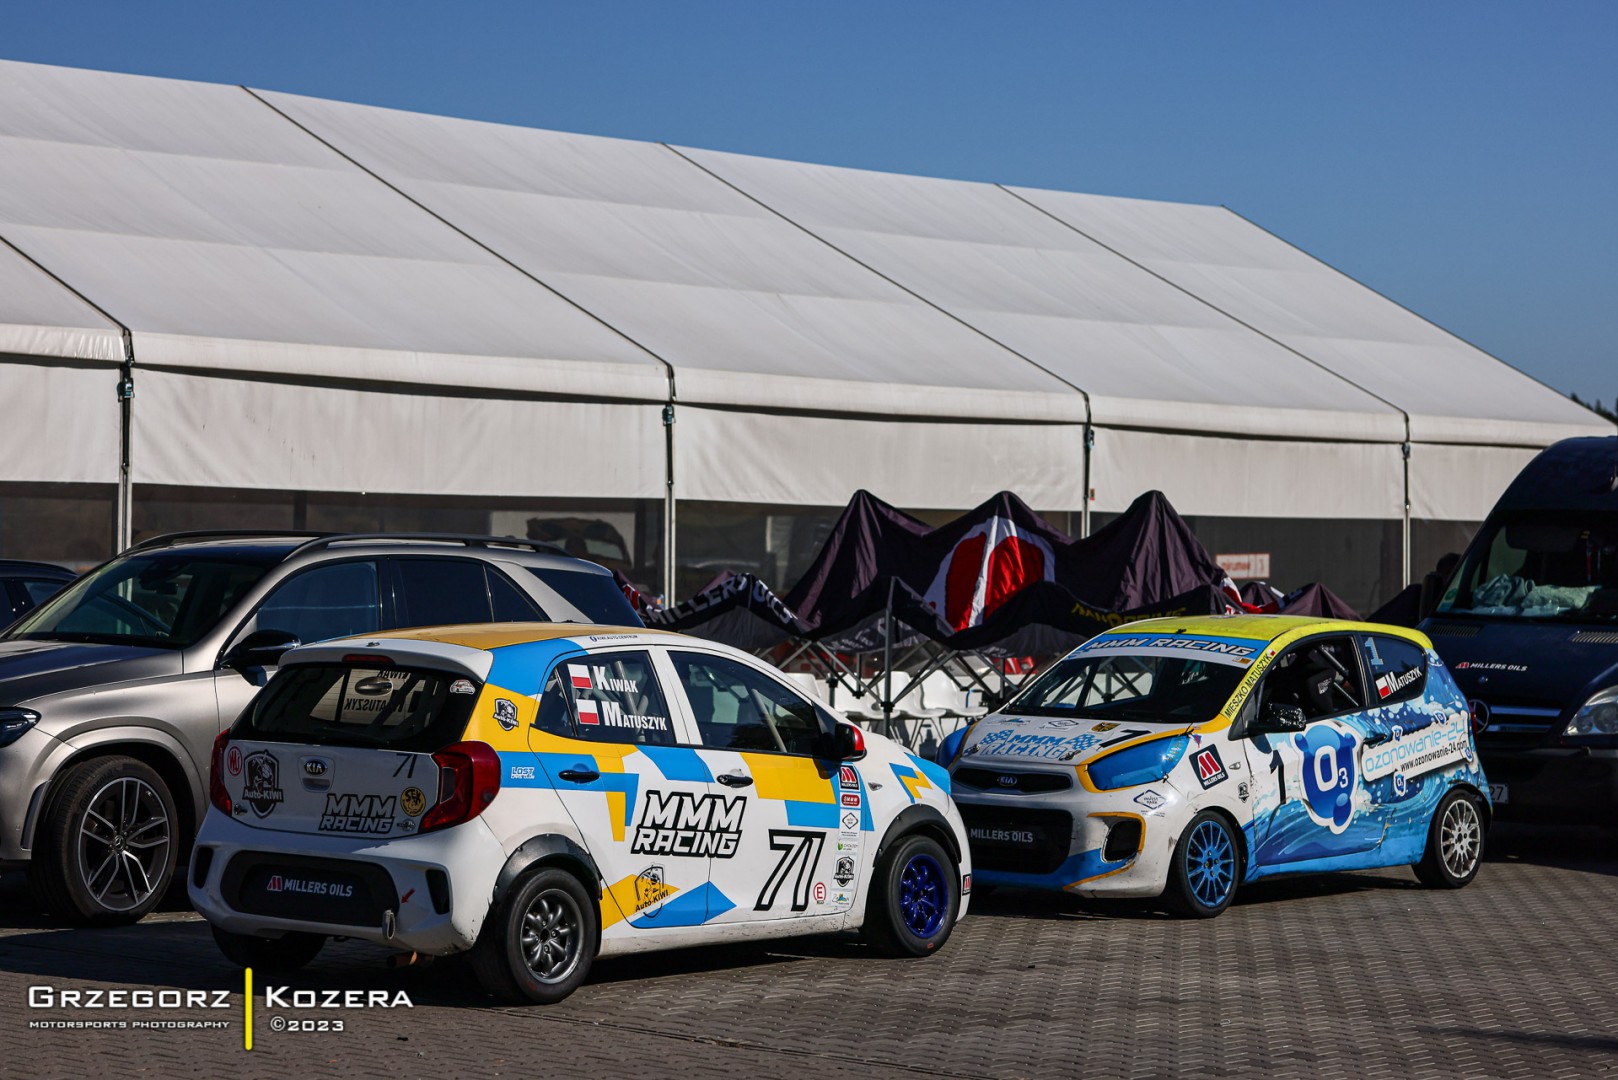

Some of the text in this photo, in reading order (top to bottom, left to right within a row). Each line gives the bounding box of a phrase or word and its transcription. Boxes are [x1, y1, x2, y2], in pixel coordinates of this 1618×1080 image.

[1085, 637, 1257, 657] MMM RACING
[1364, 637, 1384, 666] 1
[1470, 662, 1507, 670] MILLERS
[592, 666, 638, 692] KIWAK
[1224, 653, 1272, 719] MIESZKO MATUSZYK
[1384, 666, 1422, 694] MATUSZYK
[601, 701, 667, 730] MATUSZYK
[980, 743, 1067, 759] RACING
[1006, 733, 1067, 746] MMM
[1365, 719, 1466, 773] ozonowanie-24
[306, 763, 324, 773] KIA
[392, 753, 417, 778] 71
[511, 767, 534, 775] LOST
[1269, 750, 1287, 804] 1
[1000, 776, 1014, 784] KIA
[243, 789, 283, 800] Auto-KIWI
[325, 793, 397, 819] MMM
[641, 790, 748, 833] MMM
[318, 815, 394, 835] RACING
[970, 828, 1034, 843] MILLERS OILS
[631, 826, 743, 859] RACING
[753, 828, 827, 912] 71
[283, 878, 353, 897] MILLERS OILS
[635, 889, 669, 912] Auto-KIWI
